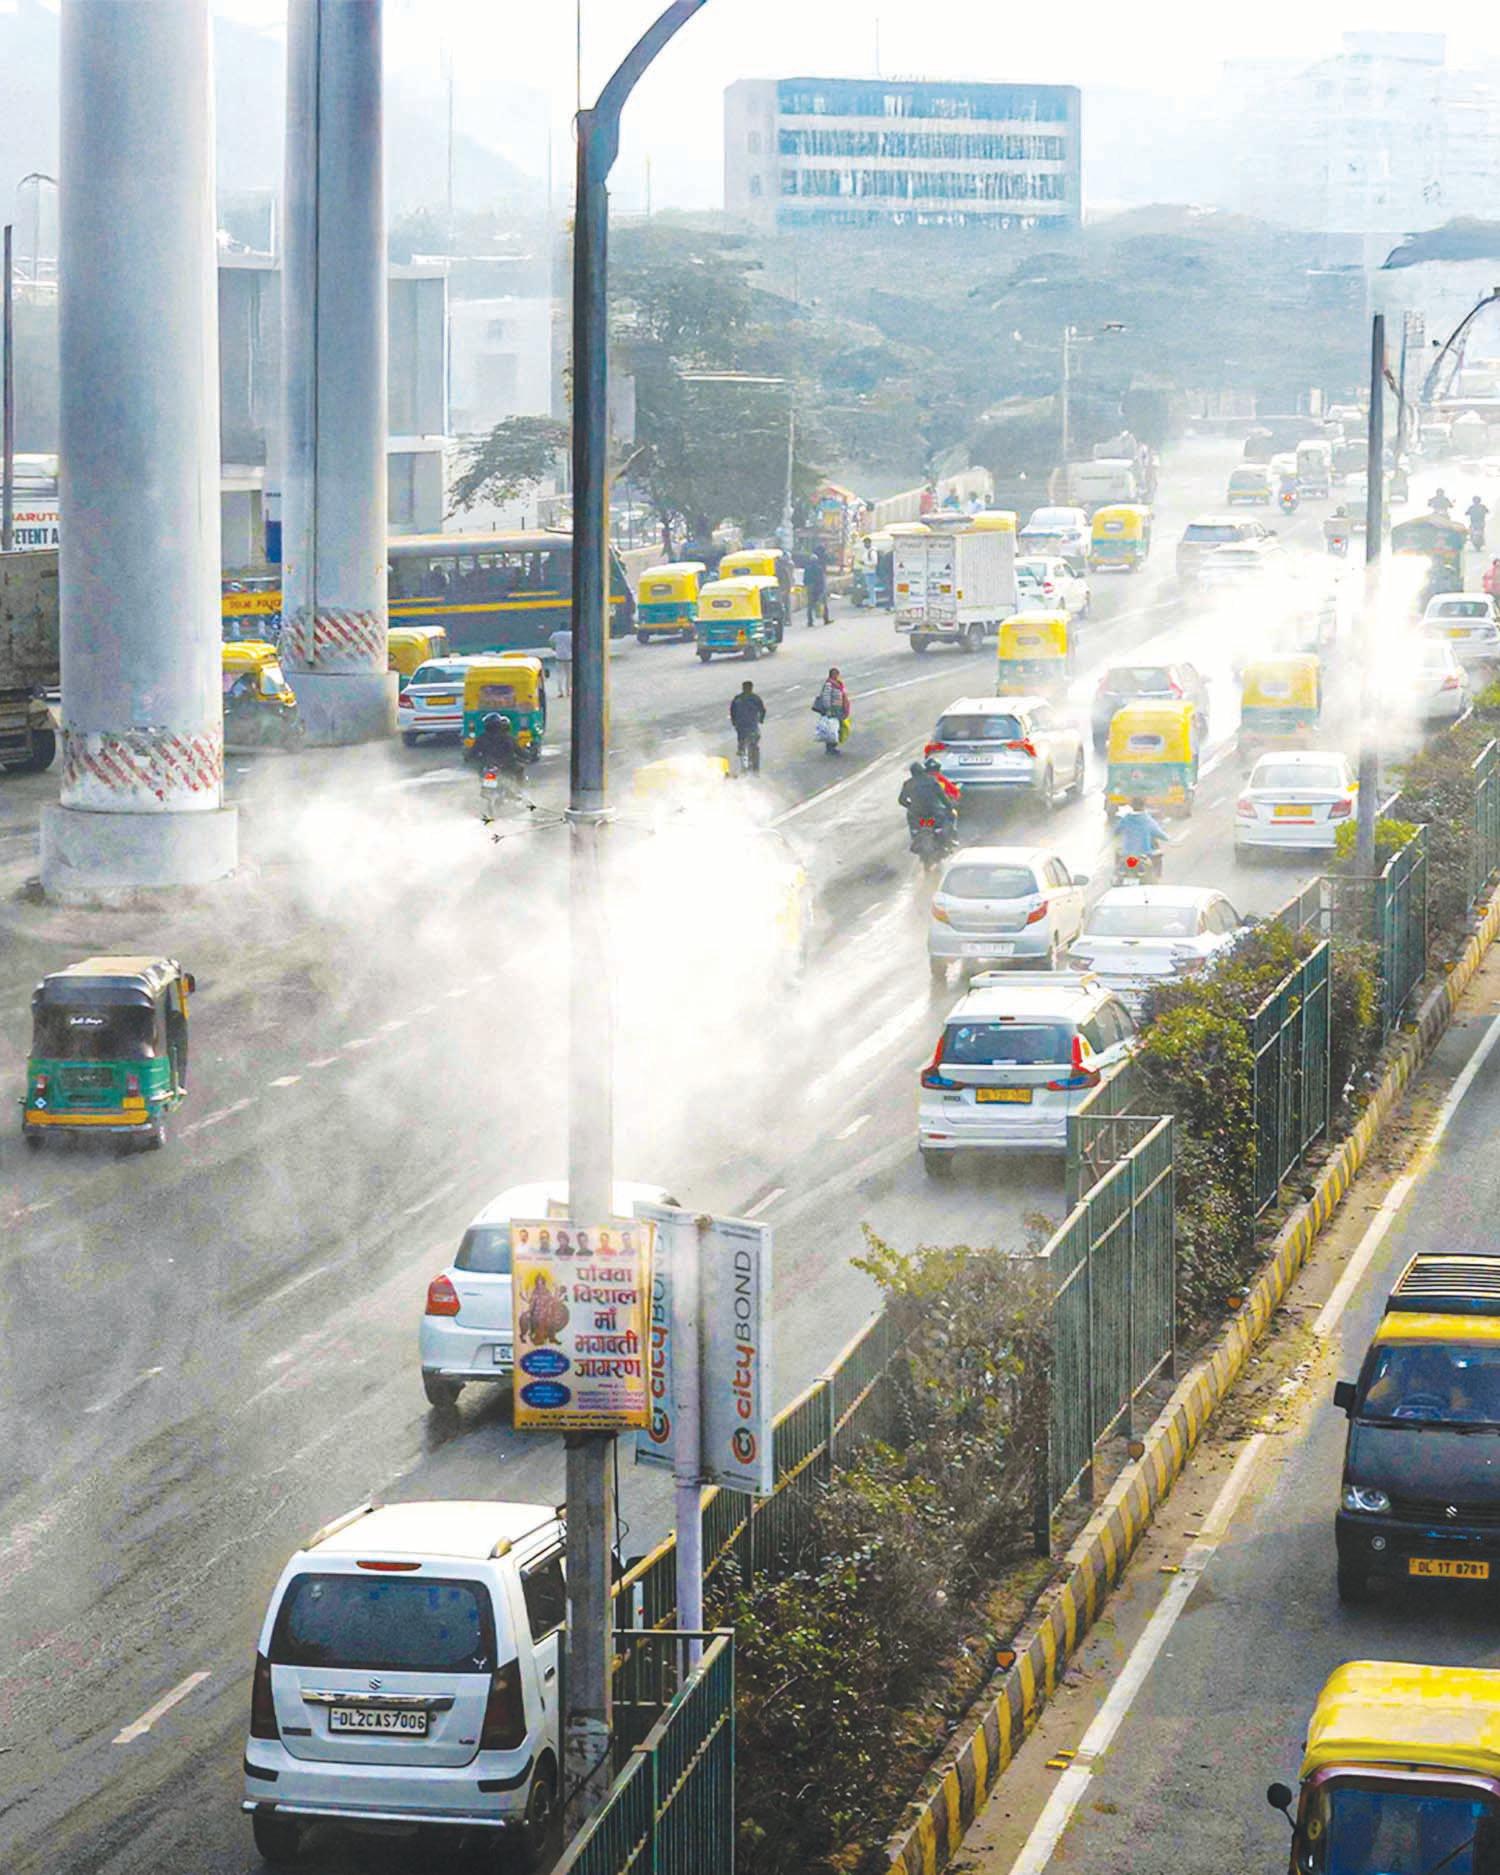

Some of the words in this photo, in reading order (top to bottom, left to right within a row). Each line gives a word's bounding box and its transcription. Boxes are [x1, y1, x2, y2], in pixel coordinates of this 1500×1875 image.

[12, 528, 48, 544] ETENT
[573, 1284, 638, 1304] विशाल
[575, 1329, 638, 1354] भगवती
[574, 1358, 641, 1378] जागरण
